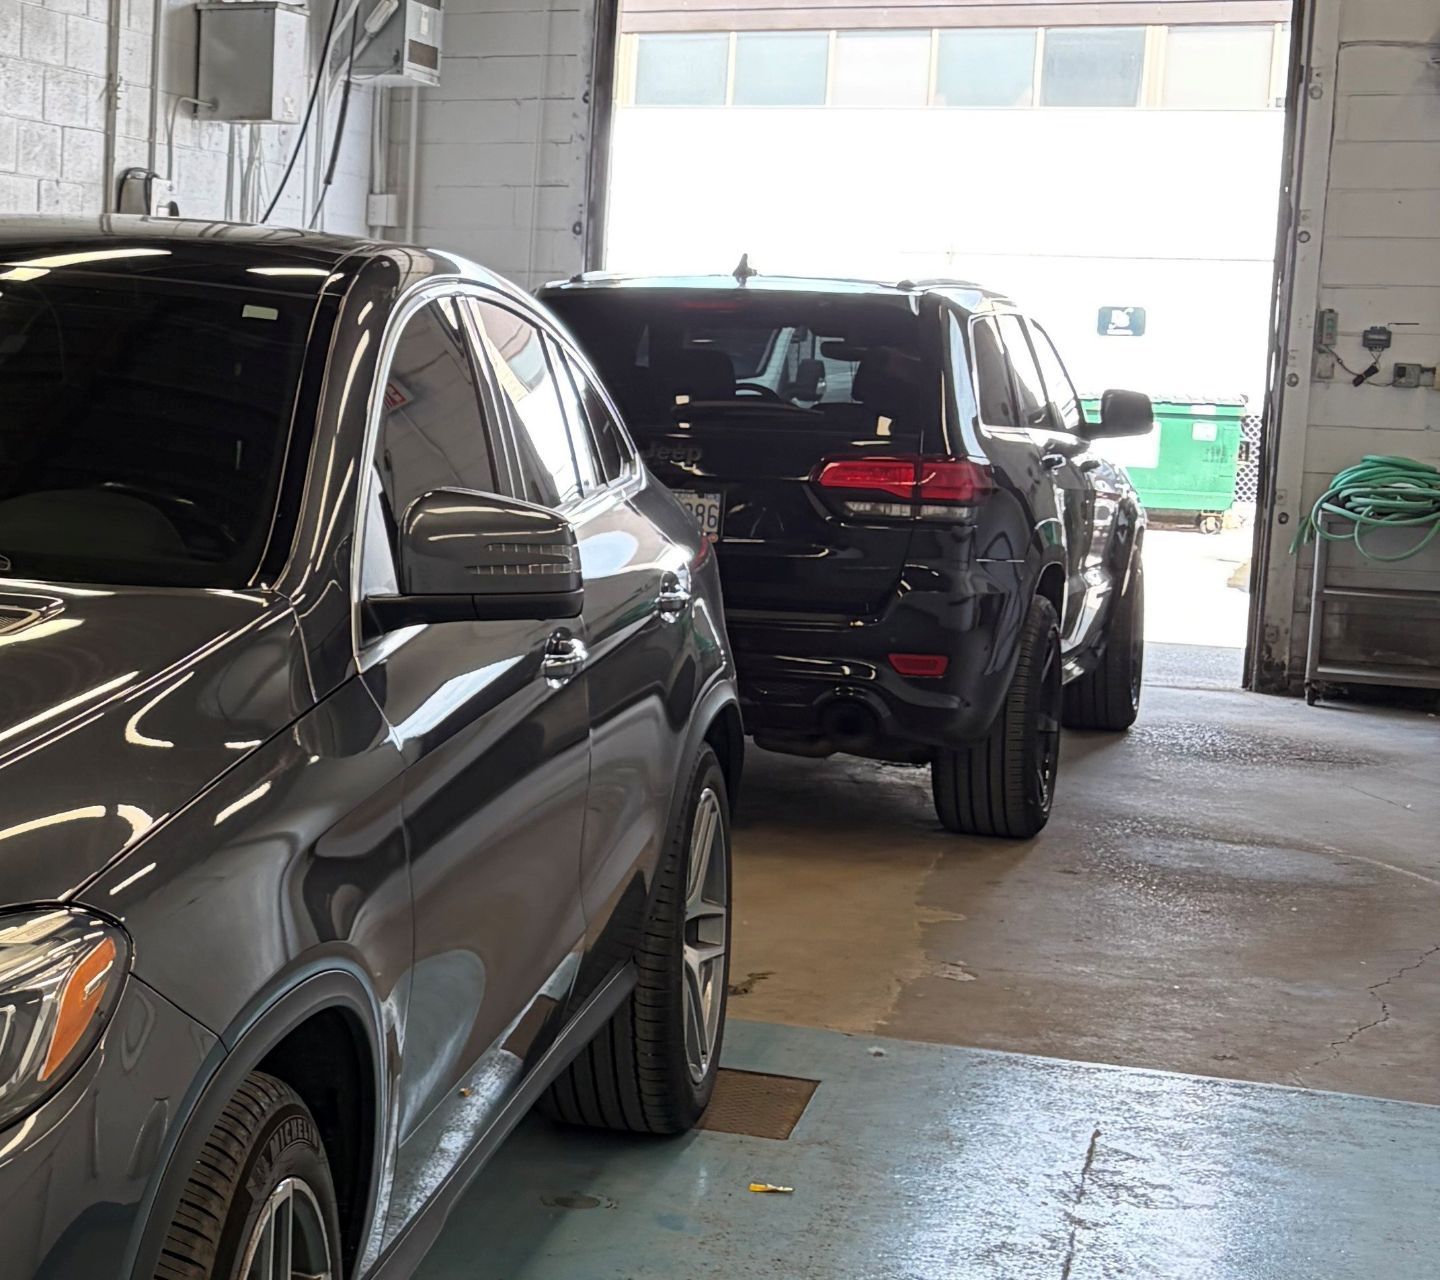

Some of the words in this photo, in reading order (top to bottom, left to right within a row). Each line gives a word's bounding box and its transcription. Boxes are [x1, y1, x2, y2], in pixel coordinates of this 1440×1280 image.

[640, 440, 704, 464] Jeep
[684, 502, 719, 529] 86
[269, 1117, 319, 1161] MICHELIN
